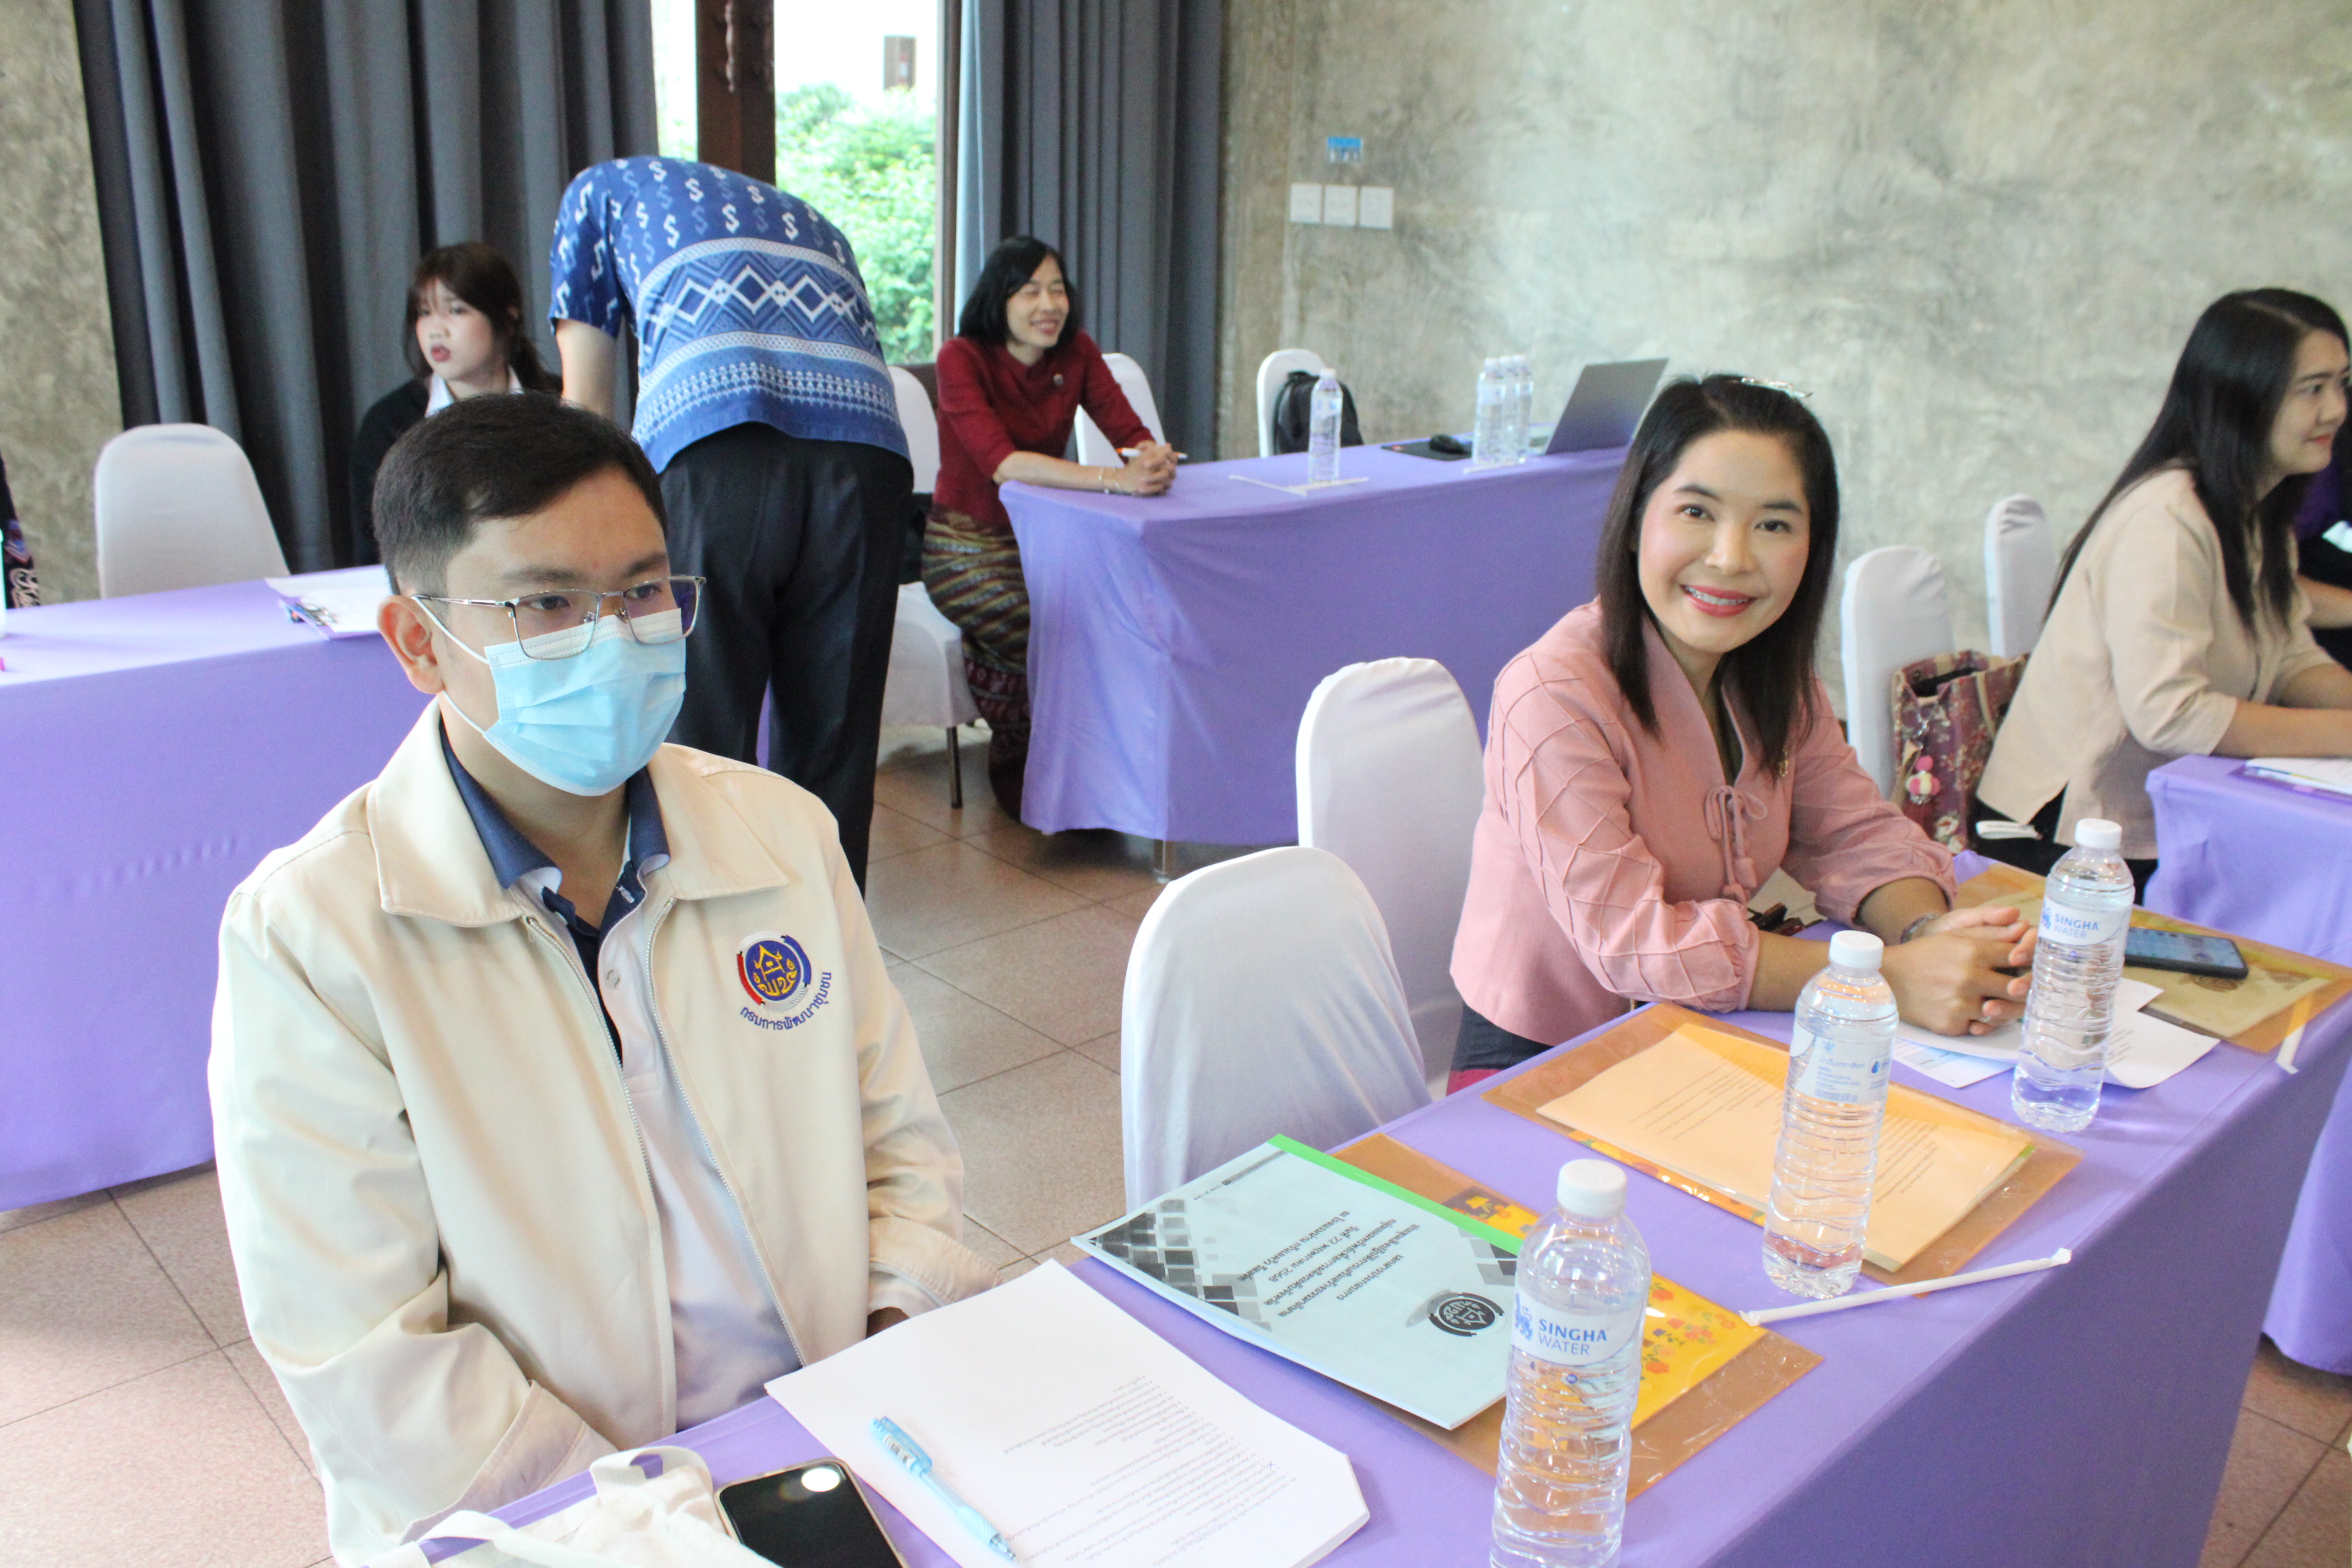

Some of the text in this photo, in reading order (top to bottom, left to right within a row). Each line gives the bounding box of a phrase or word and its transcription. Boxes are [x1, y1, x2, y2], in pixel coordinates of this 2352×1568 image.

[2054, 925, 2087, 939] WATER
[2055, 914, 2099, 930] SINGHA
[740, 972, 832, 1030] กรมการพัฒนาชุมชน
[1299, 1216, 1345, 1243] โรงแรมน่าน
[1269, 1226, 1360, 1282] วันที่ 22 พฤษภาคม 2568
[1336, 1254, 1403, 1301] เอกสารประกอบการ
[1538, 1318, 1607, 1342] SINGHA
[1538, 1332, 1590, 1355] WATER
